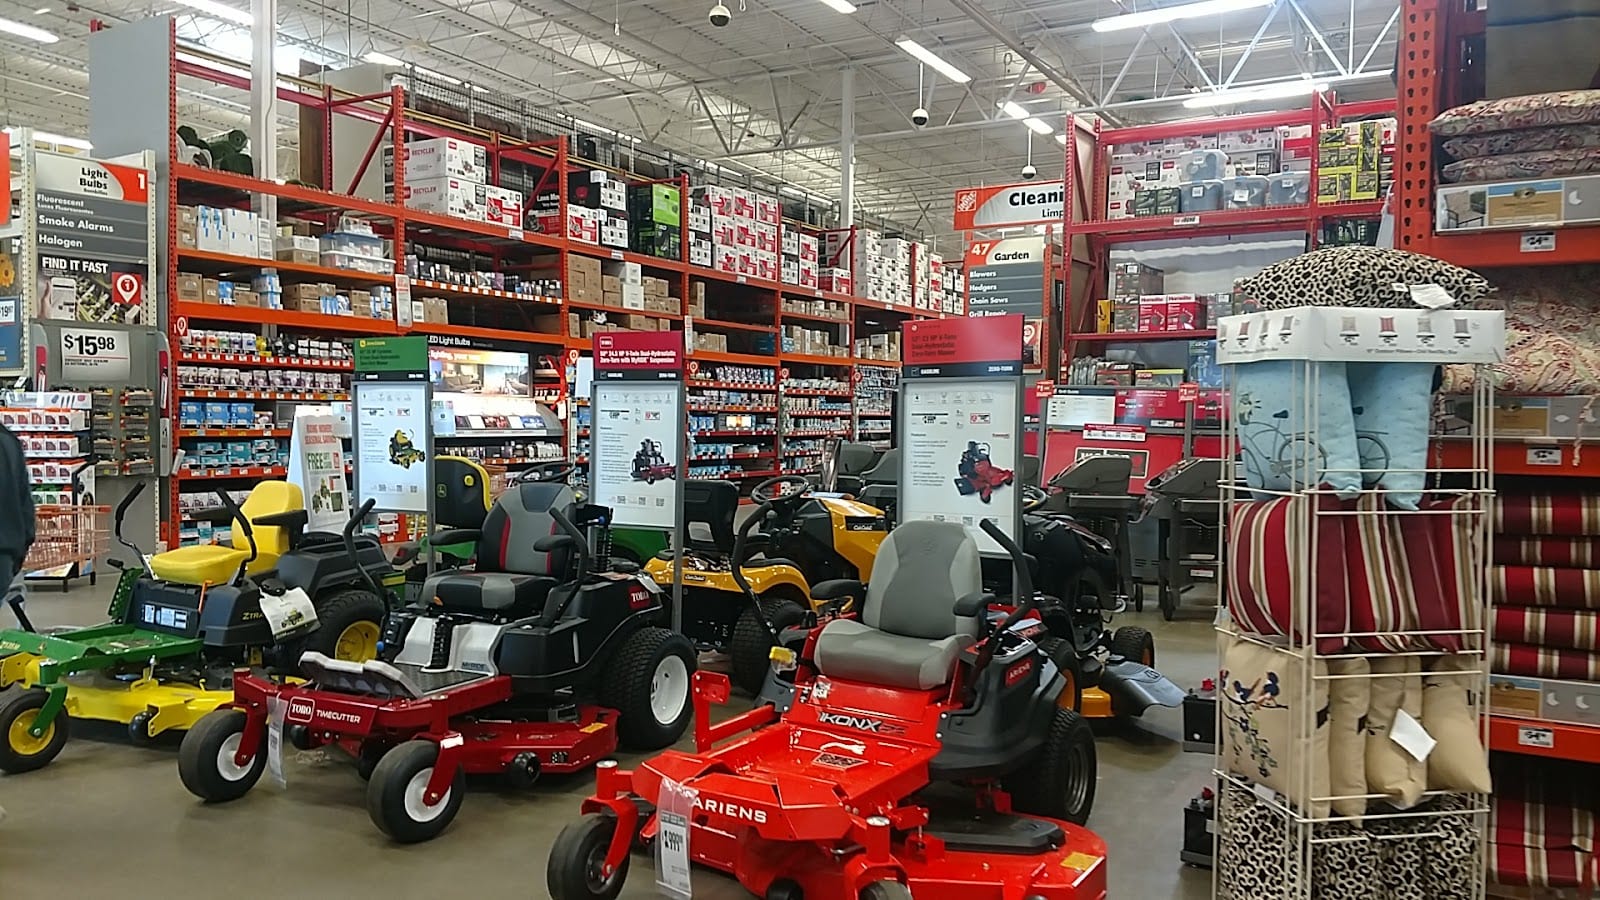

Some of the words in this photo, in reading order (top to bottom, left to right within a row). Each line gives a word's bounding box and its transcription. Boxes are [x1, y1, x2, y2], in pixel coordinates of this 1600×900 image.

[411, 147, 435, 156] RECYCLER
[81, 167, 108, 180] Light
[79, 178, 108, 190] Bulbs
[137, 172, 146, 190] 1
[413, 186, 437, 195] RECYCLER
[37, 193, 84, 207] Fluorescent
[38, 214, 75, 228] Smoke
[77, 219, 114, 233] Alarms
[38, 233, 83, 248] Halogen
[971, 242, 991, 256] 47
[994, 251, 1030, 261] Garden
[42, 256, 67, 270] FIND
[69, 259, 81, 270] IT
[82, 260, 109, 274] FAST
[969, 270, 997, 278] Blowers
[969, 283, 997, 292] Hedgers
[969, 296, 989, 305] Chain
[990, 295, 1009, 304] Saws
[968, 310, 984, 318] Grill
[439, 335, 454, 346] Light
[454, 337, 471, 347] Bulbs
[307, 452, 323, 469] FREE
[291, 703, 312, 715] TORO
[316, 709, 361, 724] TIMECUTTER
[693, 796, 767, 824] ARIENS
